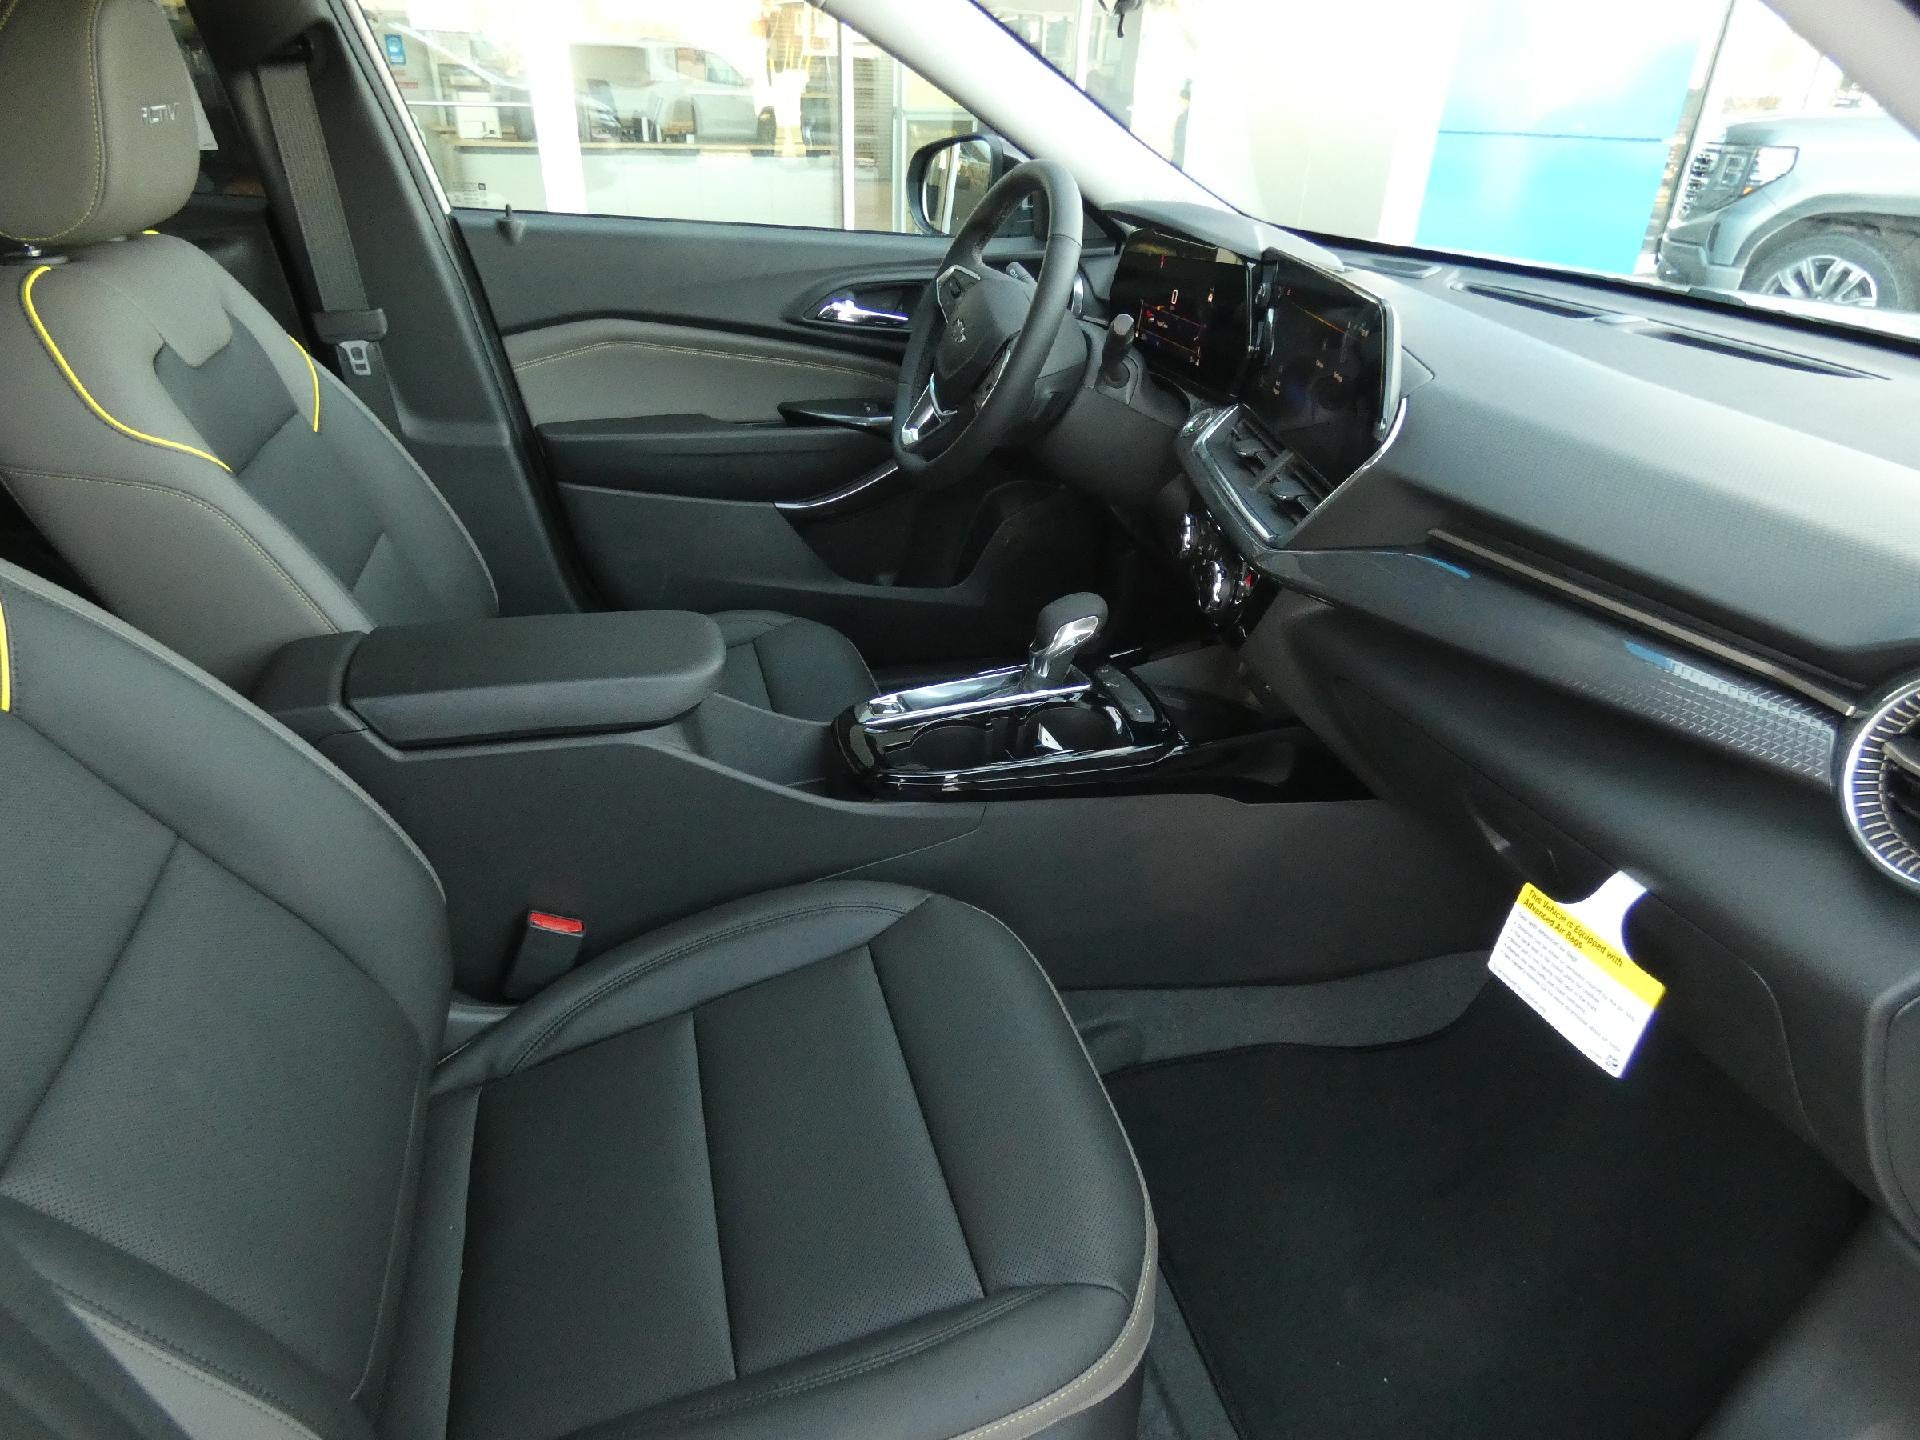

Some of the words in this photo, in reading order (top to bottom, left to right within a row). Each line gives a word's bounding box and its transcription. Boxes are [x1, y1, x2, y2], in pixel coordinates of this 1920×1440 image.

[1542, 897, 1567, 922] Vehicle
[1573, 925, 1607, 955] Equipped
[1606, 949, 1624, 967] with
[1564, 931, 1583, 950] Bags
